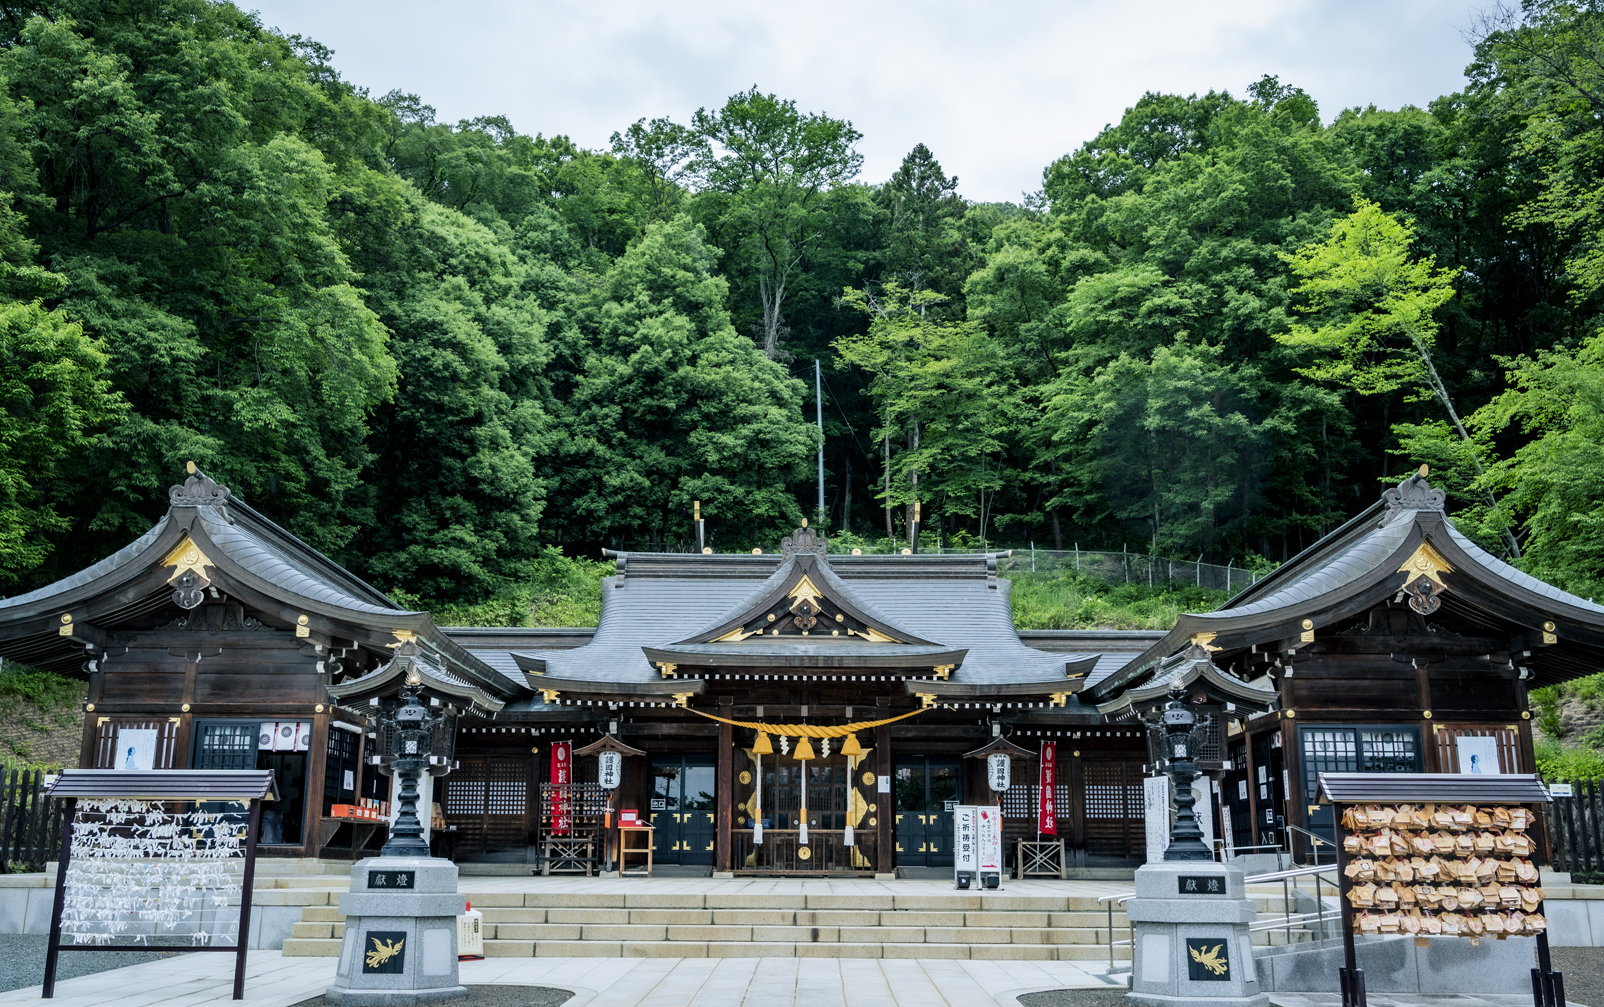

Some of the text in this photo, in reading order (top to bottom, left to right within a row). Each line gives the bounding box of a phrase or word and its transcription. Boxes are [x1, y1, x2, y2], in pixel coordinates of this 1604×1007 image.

[962, 813, 970, 862] ご祈祷受付
[1261, 831, 1274, 844] 入口
